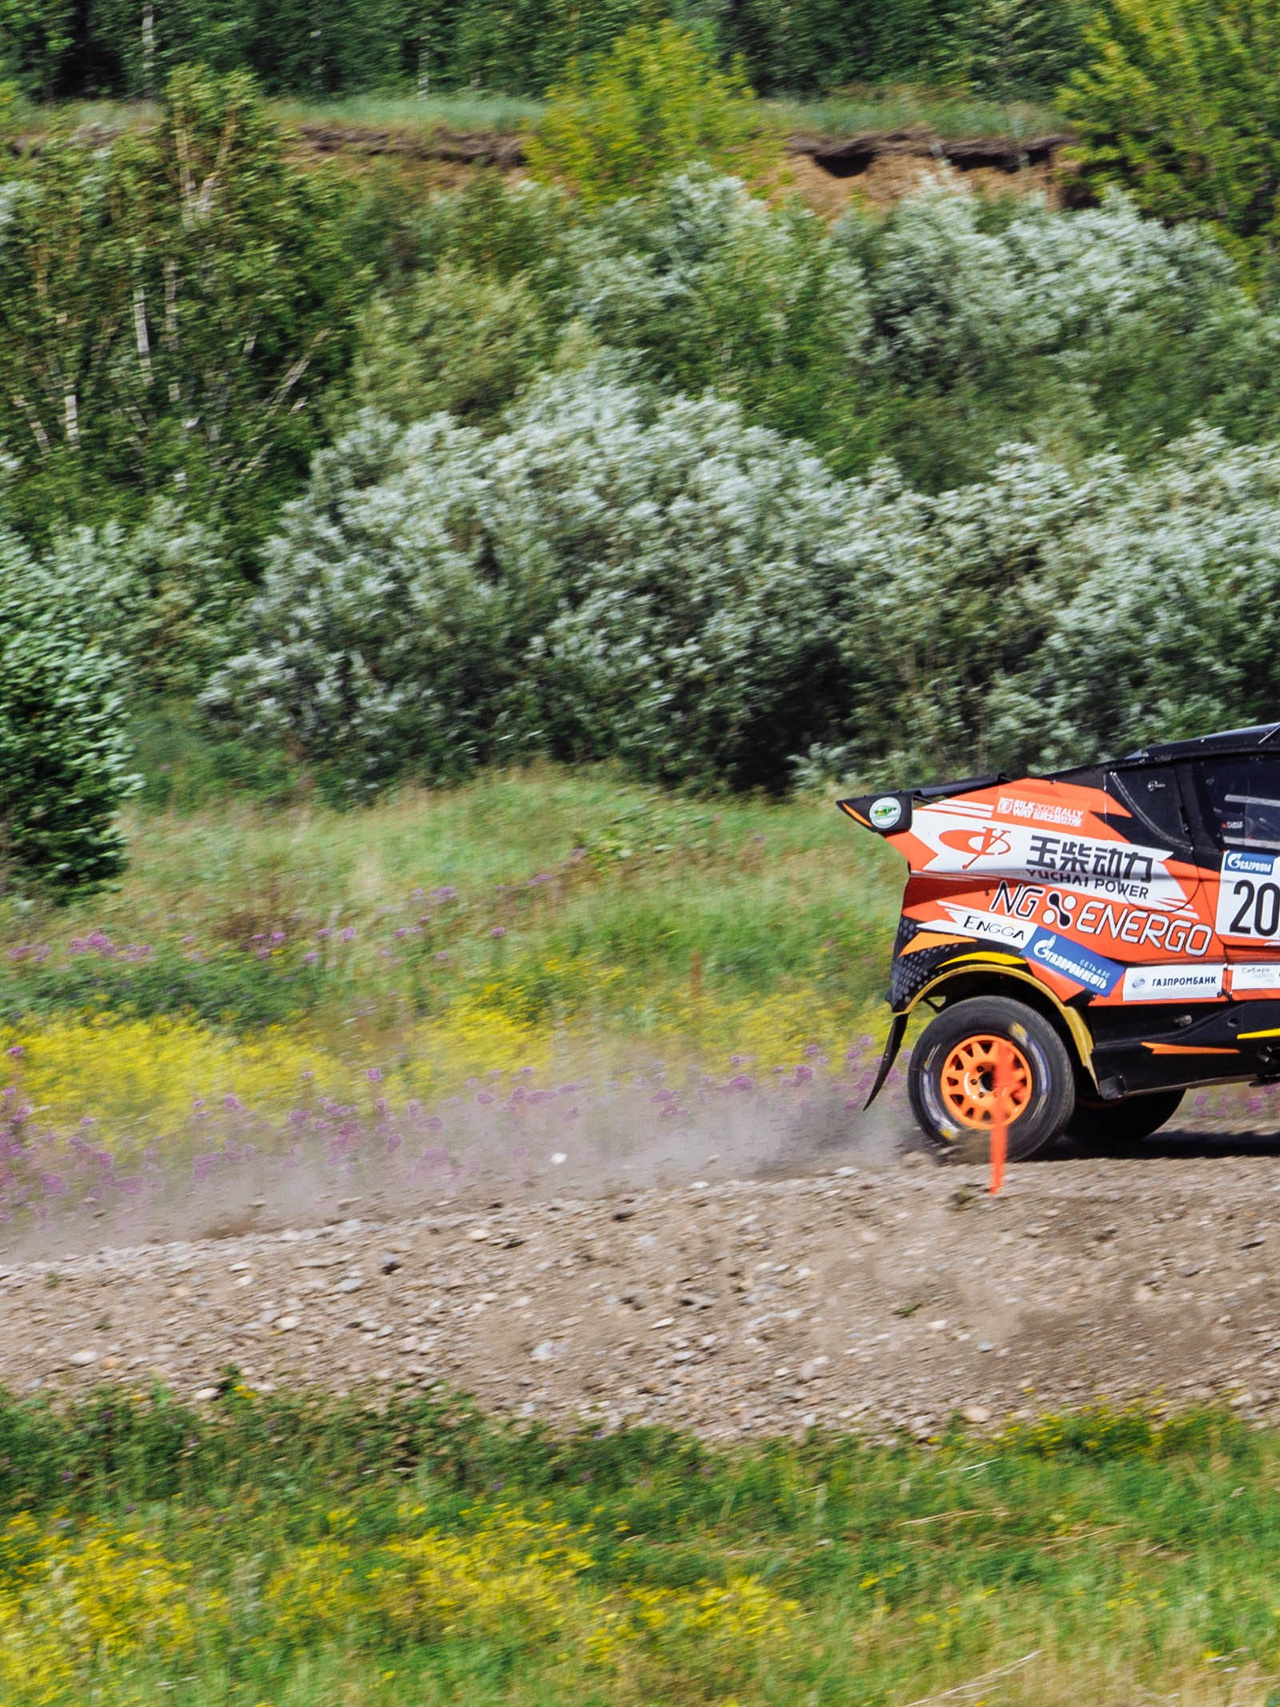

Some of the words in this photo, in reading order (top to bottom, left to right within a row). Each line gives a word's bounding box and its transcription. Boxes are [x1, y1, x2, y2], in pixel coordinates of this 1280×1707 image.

[1055, 806, 1084, 818] RALLY
[1026, 834, 1154, 883] 玉柴动力
[1026, 868, 1090, 888] YUCHAI
[1093, 876, 1150, 900] POWER
[963, 915, 1025, 941] ENGGA
[989, 878, 1044, 919] NG
[1076, 900, 1214, 957] ENERGO
[1045, 951, 1108, 990] ГАЗПРОМНЕФТЬ
[1152, 976, 1217, 987] ГАЗПРОМБАНК
